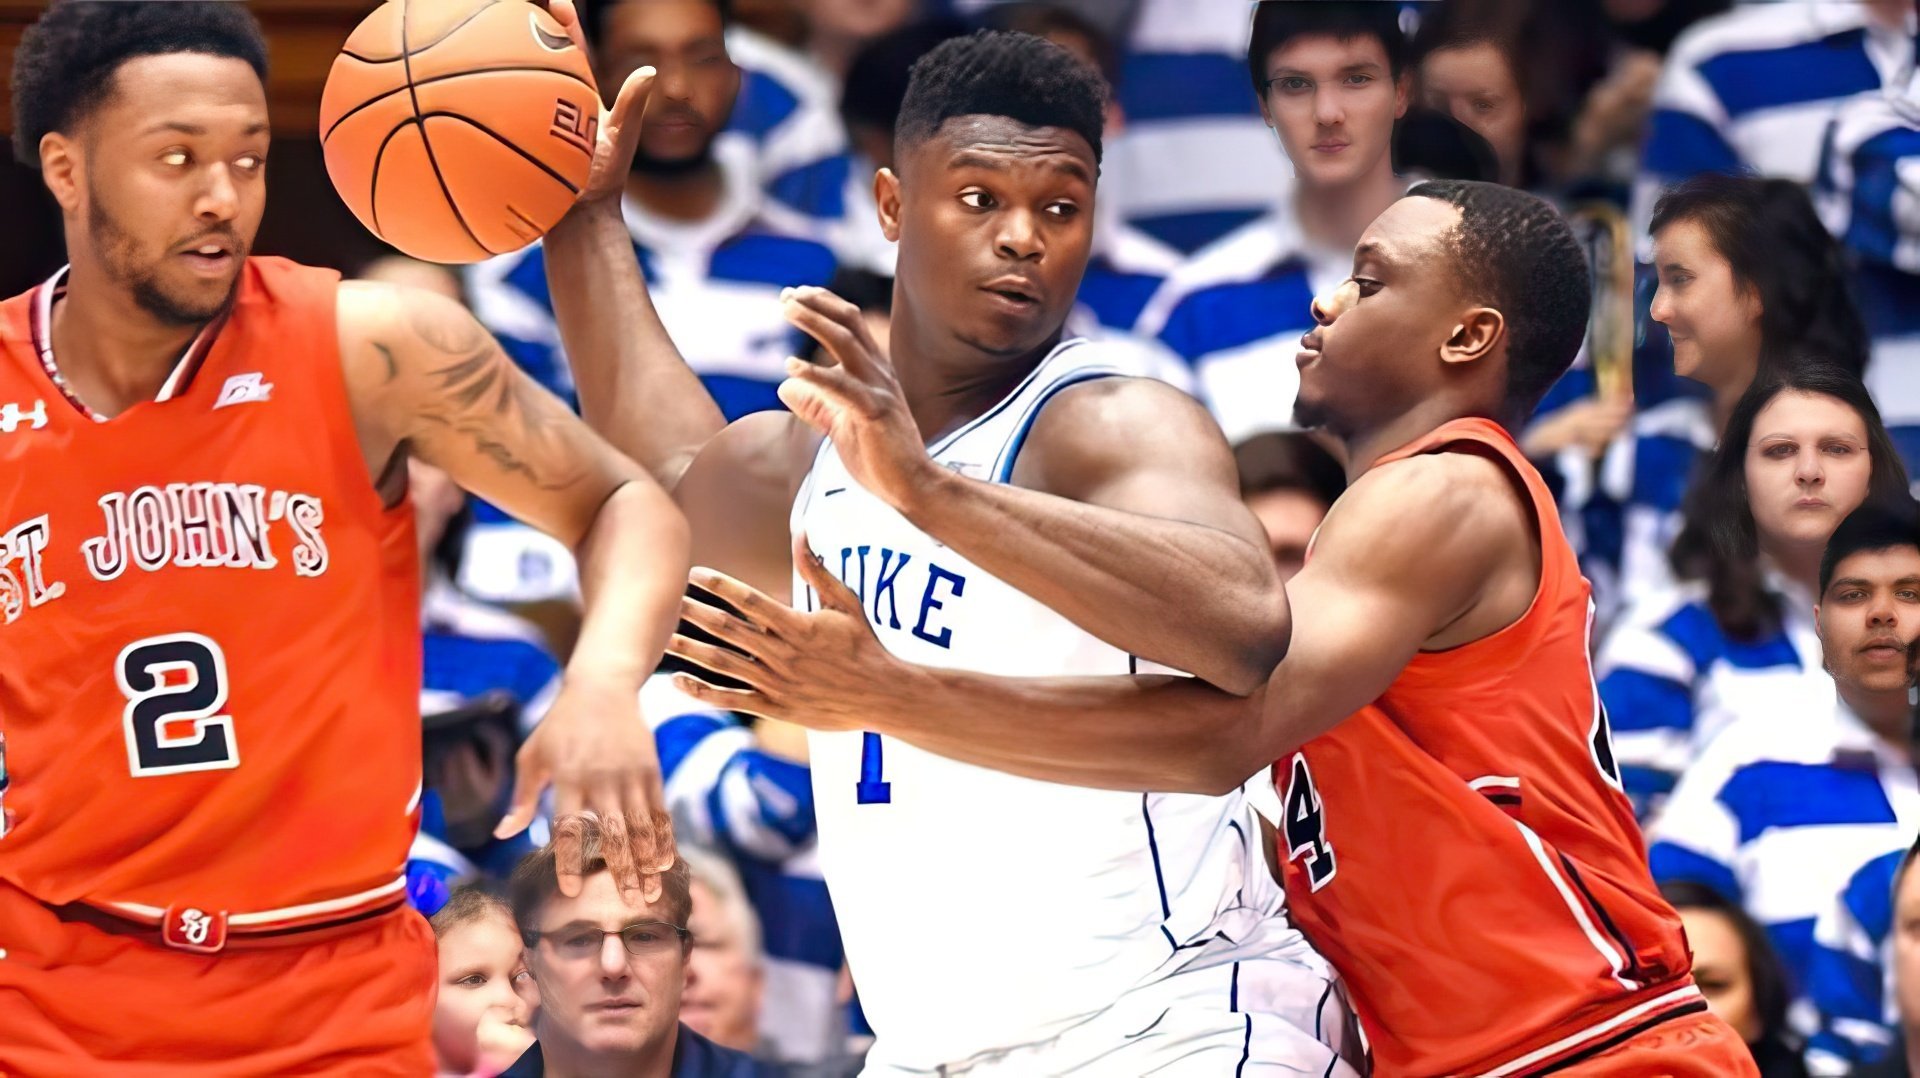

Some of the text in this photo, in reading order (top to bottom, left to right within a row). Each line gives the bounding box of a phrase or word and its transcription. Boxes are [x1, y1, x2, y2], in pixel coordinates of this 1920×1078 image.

[81, 481, 330, 582] JOHN'S
[807, 545, 966, 650] UKE
[115, 631, 240, 778] 2
[1283, 751, 1338, 895] 4
